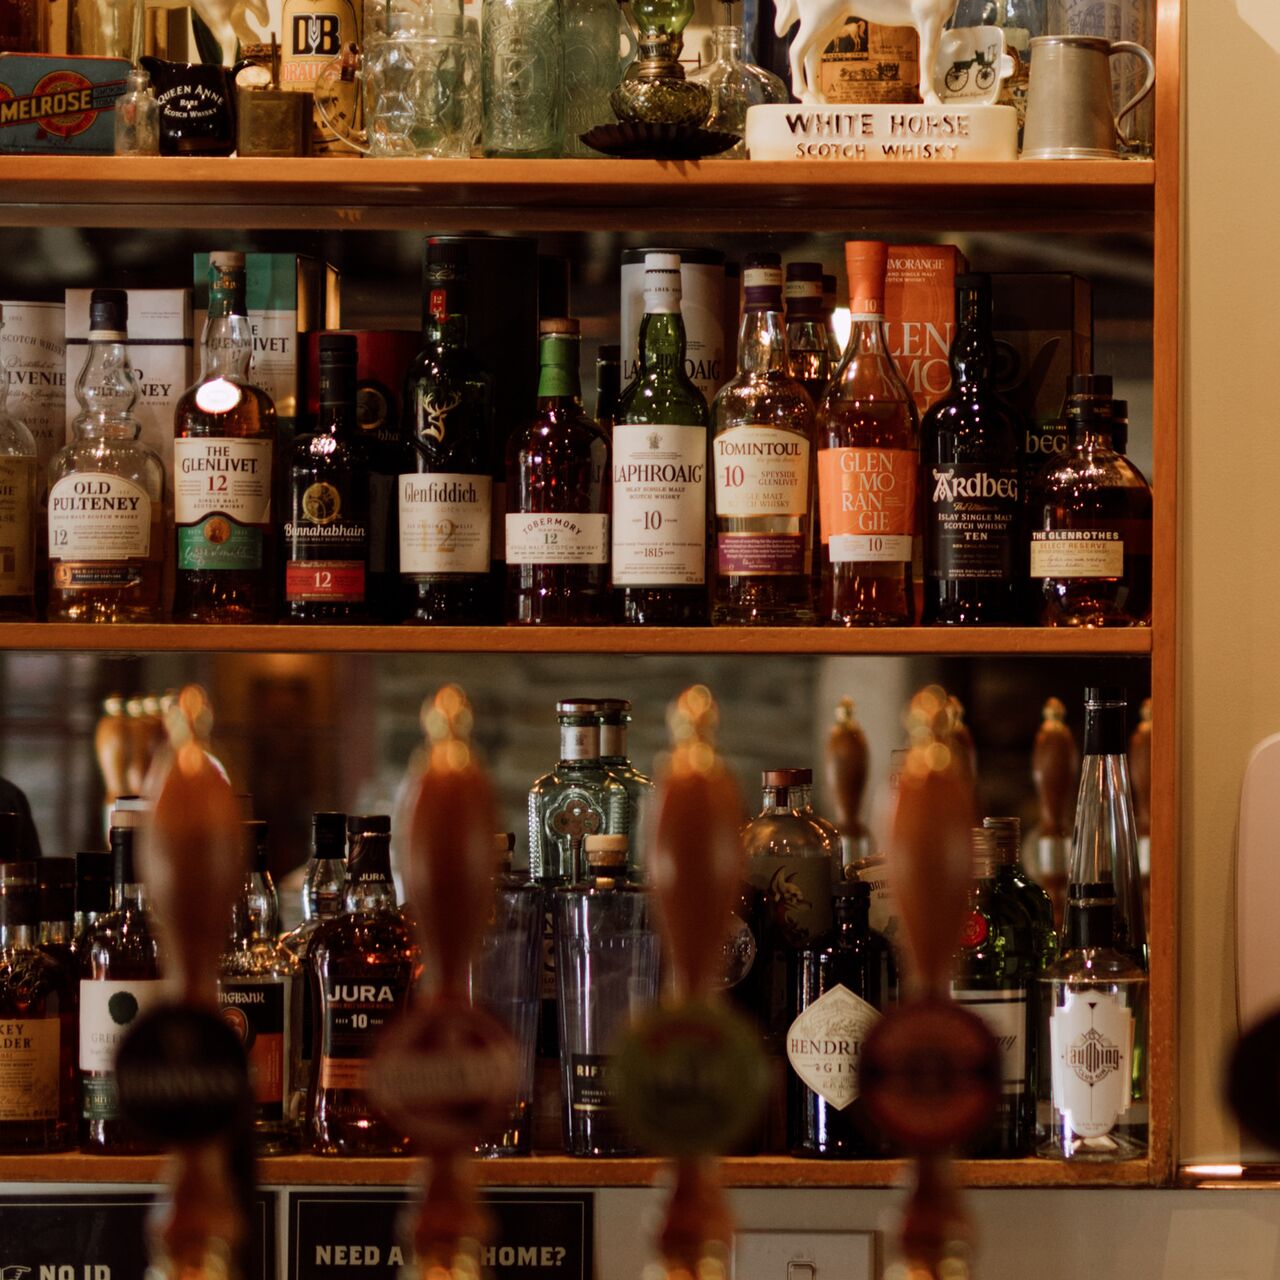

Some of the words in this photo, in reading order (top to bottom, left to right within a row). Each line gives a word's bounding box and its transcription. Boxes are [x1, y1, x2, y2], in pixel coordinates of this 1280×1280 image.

[157, 84, 192, 105] QUEEN
[194, 84, 224, 106] ANNE
[0, 88, 92, 123] MELROSE
[785, 113, 874, 137] WHITE
[890, 113, 971, 137] HORSE
[796, 143, 867, 161] SCOTCH
[881, 143, 961, 161] WHISKY
[864, 299, 877, 312] 10
[2, 334, 37, 345] SCOTCH
[8, 371, 66, 386] LVENIE
[206, 446, 230, 457] THE
[718, 440, 802, 456] TOMINTOUL
[840, 452, 894, 473] GLEN
[614, 463, 704, 483] LAPHROAIG
[724, 465, 745, 488] 10
[761, 470, 796, 479] SPEYSIDE
[74, 481, 111, 495] OLD
[207, 474, 228, 492] 12
[758, 478, 798, 487] GLENLIVET
[860, 472, 895, 492] MO
[404, 481, 477, 504] Glenfiddich
[762, 492, 784, 500] MALT
[53, 496, 140, 511] PULTENEY
[760, 500, 791, 508] WHISKY
[842, 492, 883, 512] RAN
[644, 510, 663, 530] 10
[859, 511, 890, 531] GIE
[938, 512, 960, 521] ISLAY
[961, 512, 992, 521] SINGLE
[994, 513, 1013, 521] MALT
[283, 523, 367, 537] Bunnahabhain
[522, 517, 583, 536] TOBERMORY
[943, 522, 974, 530] SCOTCH
[976, 522, 1008, 530] WHISKY
[53, 528, 68, 546] 12
[544, 532, 558, 545] 12
[964, 531, 988, 541] TEN
[1032, 531, 1047, 540] THE
[1048, 531, 1119, 540] GLENROTHES
[868, 537, 883, 552] 10
[644, 547, 664, 558] 1815
[314, 571, 332, 588] 12
[359, 873, 386, 881] JURA
[327, 985, 394, 1002] JURA
[351, 1013, 368, 1029] 10
[823, 1062, 858, 1074] GIN
[315, 1245, 381, 1266] NEED
[387, 1245, 405, 1266] A
